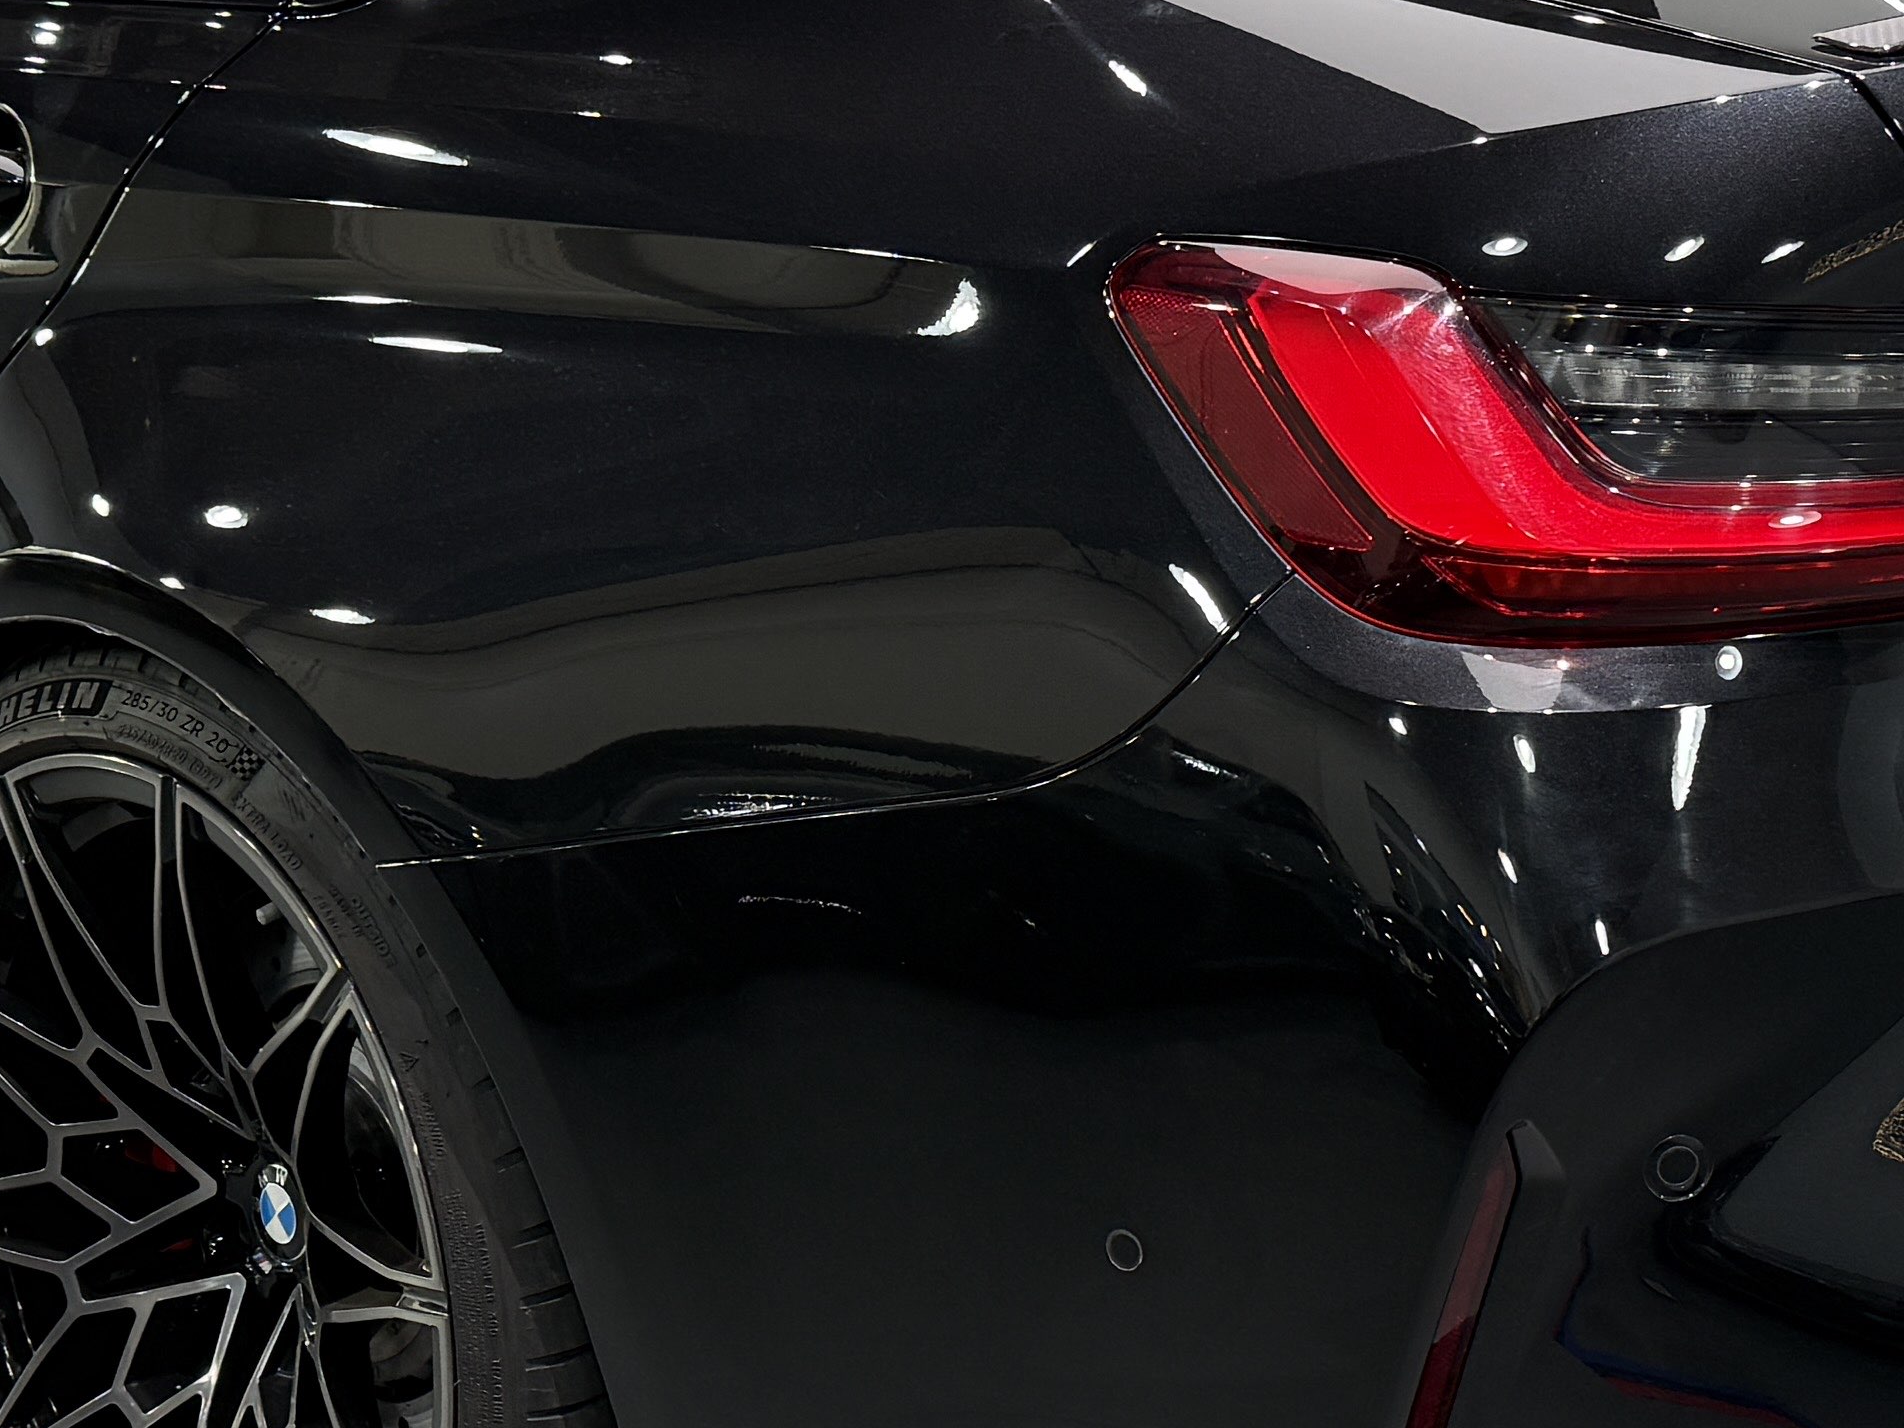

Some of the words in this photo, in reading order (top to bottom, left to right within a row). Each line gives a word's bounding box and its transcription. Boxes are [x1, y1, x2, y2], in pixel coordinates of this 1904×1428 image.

[120, 690, 179, 722] 285/30
[179, 714, 205, 737] ZR
[205, 731, 230, 754] 20
